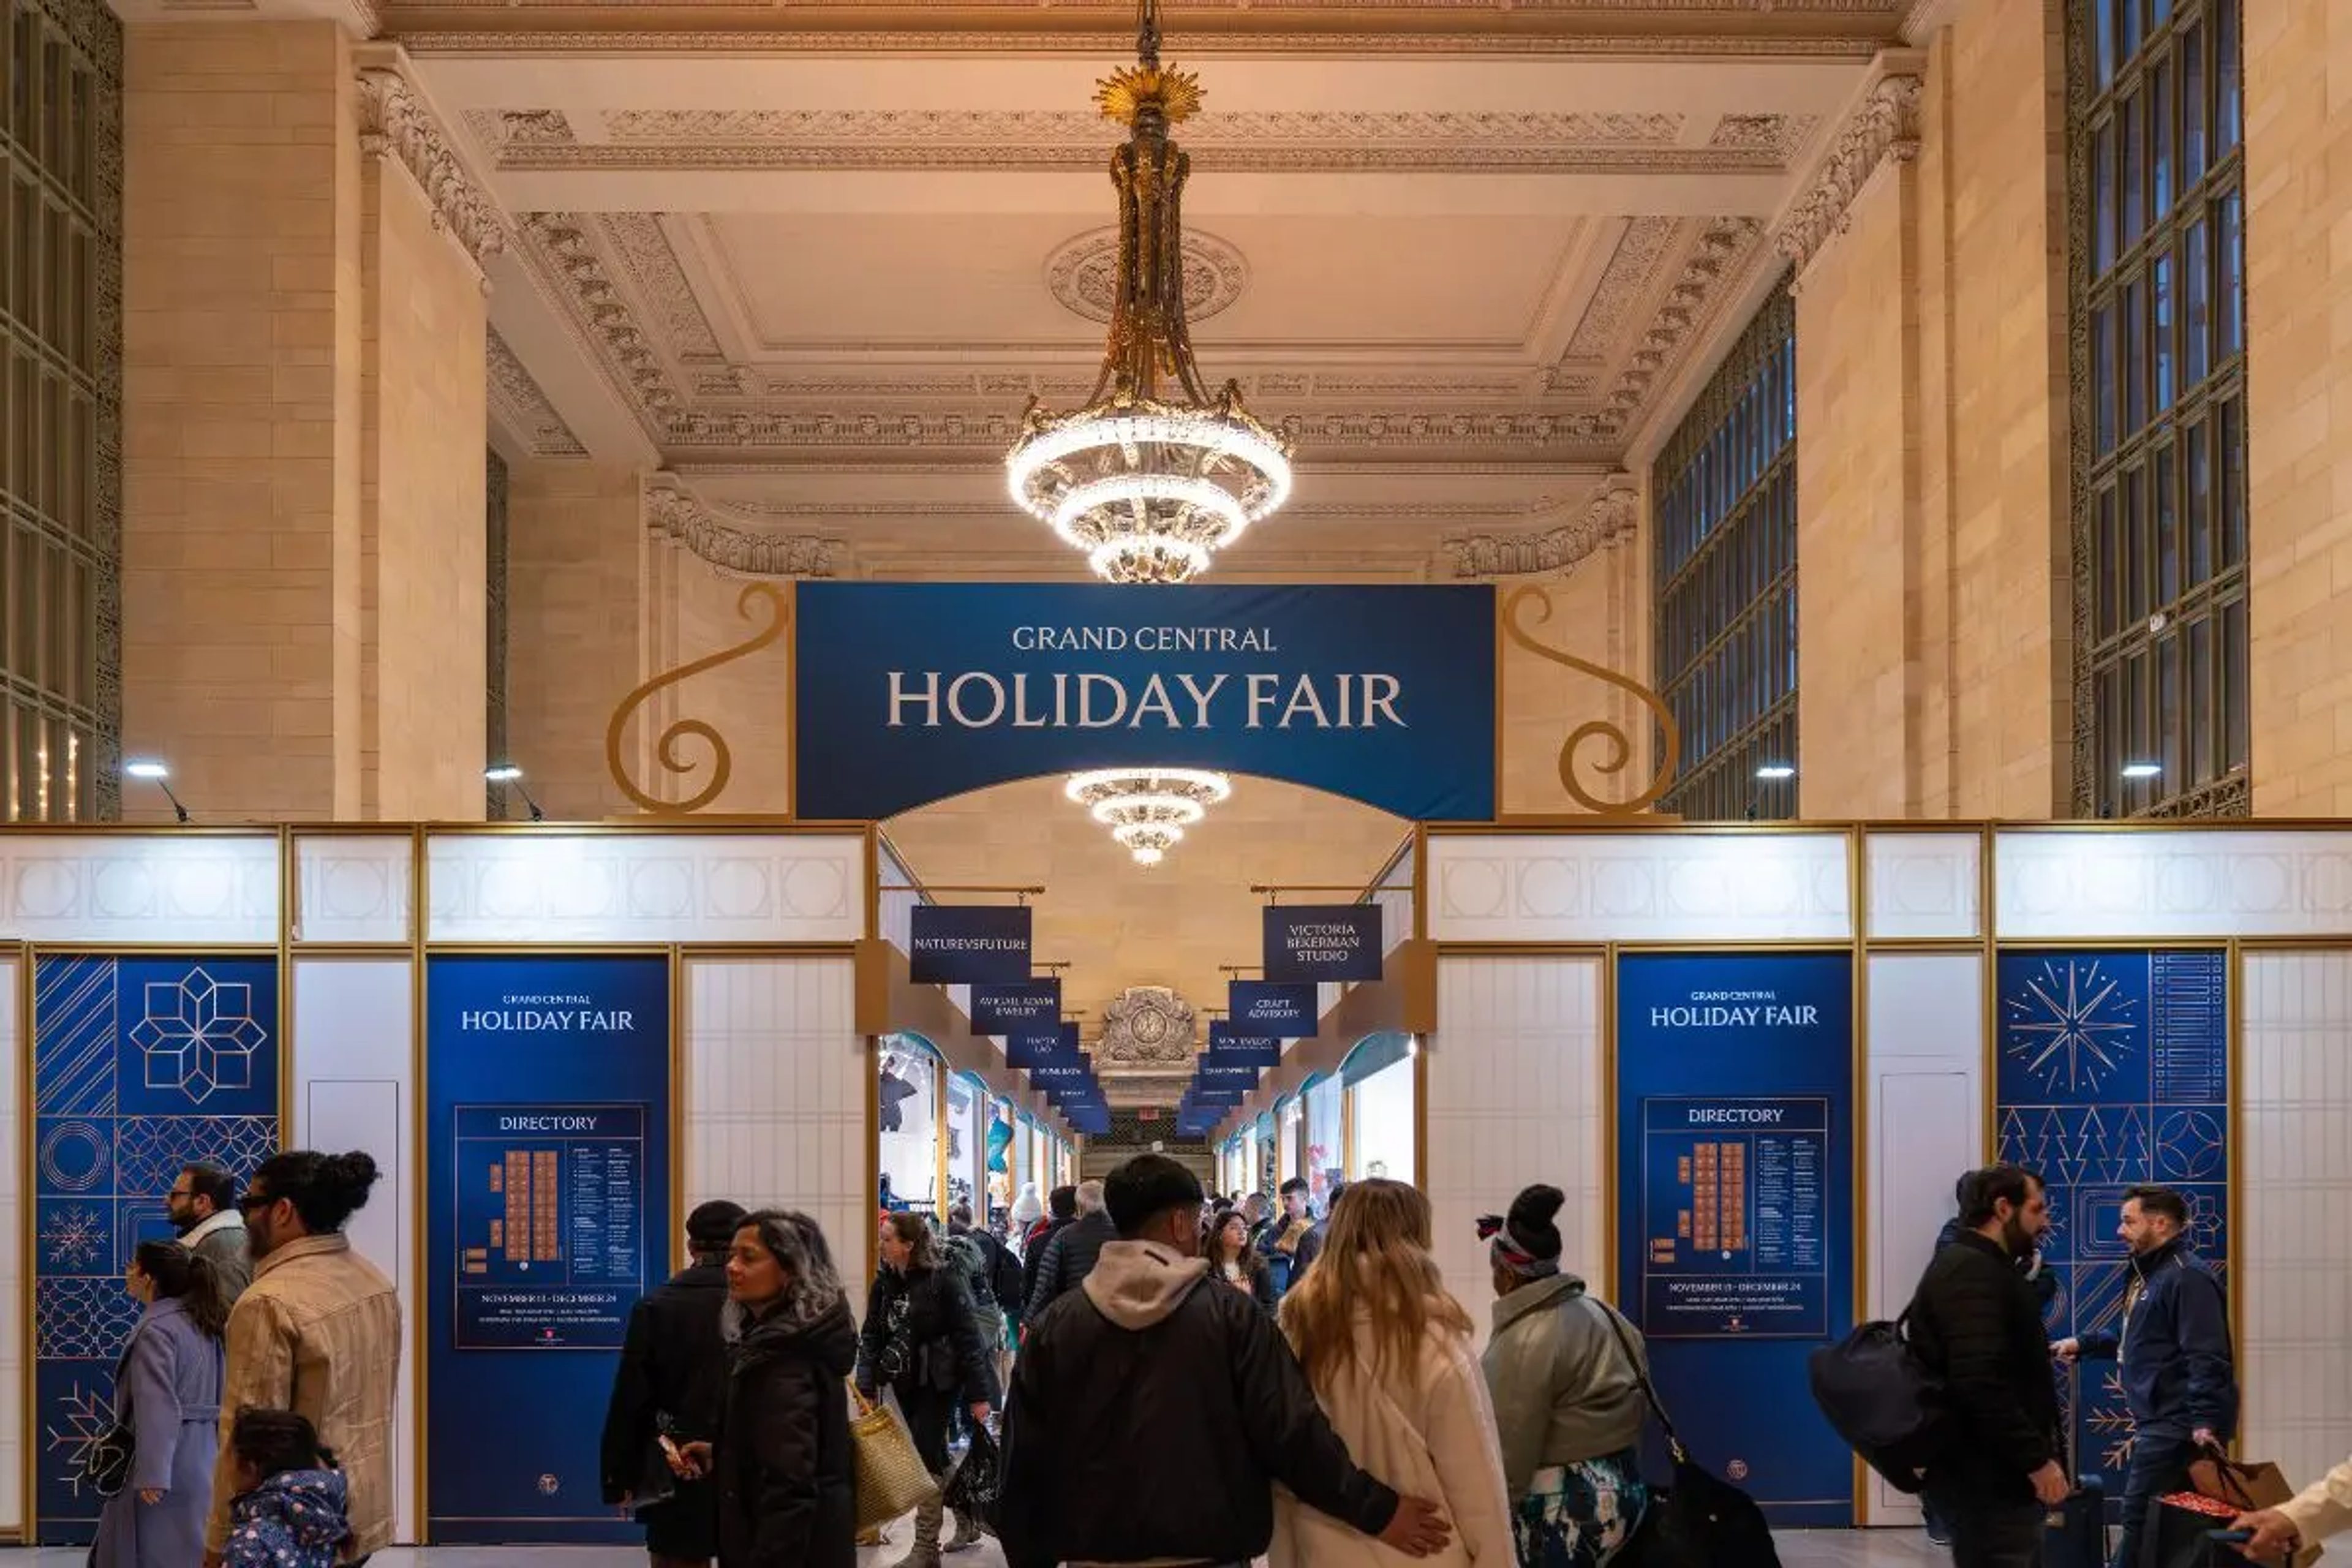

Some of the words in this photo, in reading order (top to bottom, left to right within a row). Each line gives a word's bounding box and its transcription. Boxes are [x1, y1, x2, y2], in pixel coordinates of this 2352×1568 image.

[1012, 627, 1128, 650] GRAND
[1134, 627, 1277, 651] CENTRAL
[887, 672, 1234, 728] HOLIDAY
[1246, 674, 1409, 728] FAIR
[1289, 924, 1355, 936] VICTORIA
[915, 938, 1028, 950] NATUREVSFUTURE
[1287, 937, 1359, 949] BEKERMAN
[1297, 950, 1348, 962] STUDIO
[503, 995, 541, 1004] GRAND
[543, 995, 591, 1005] CENTRAL
[1691, 991, 1727, 1001] GRAND
[1730, 990, 1776, 1000] CENTRAL
[462, 1011, 575, 1030] HOLIDAY
[579, 1011, 635, 1030] FAIR
[1650, 1006, 1761, 1027] HOLIDAY
[1765, 1005, 1818, 1025] FAIR
[1689, 1109, 1784, 1123] DIRECTORY
[500, 1116, 597, 1131] DIRECTORY
